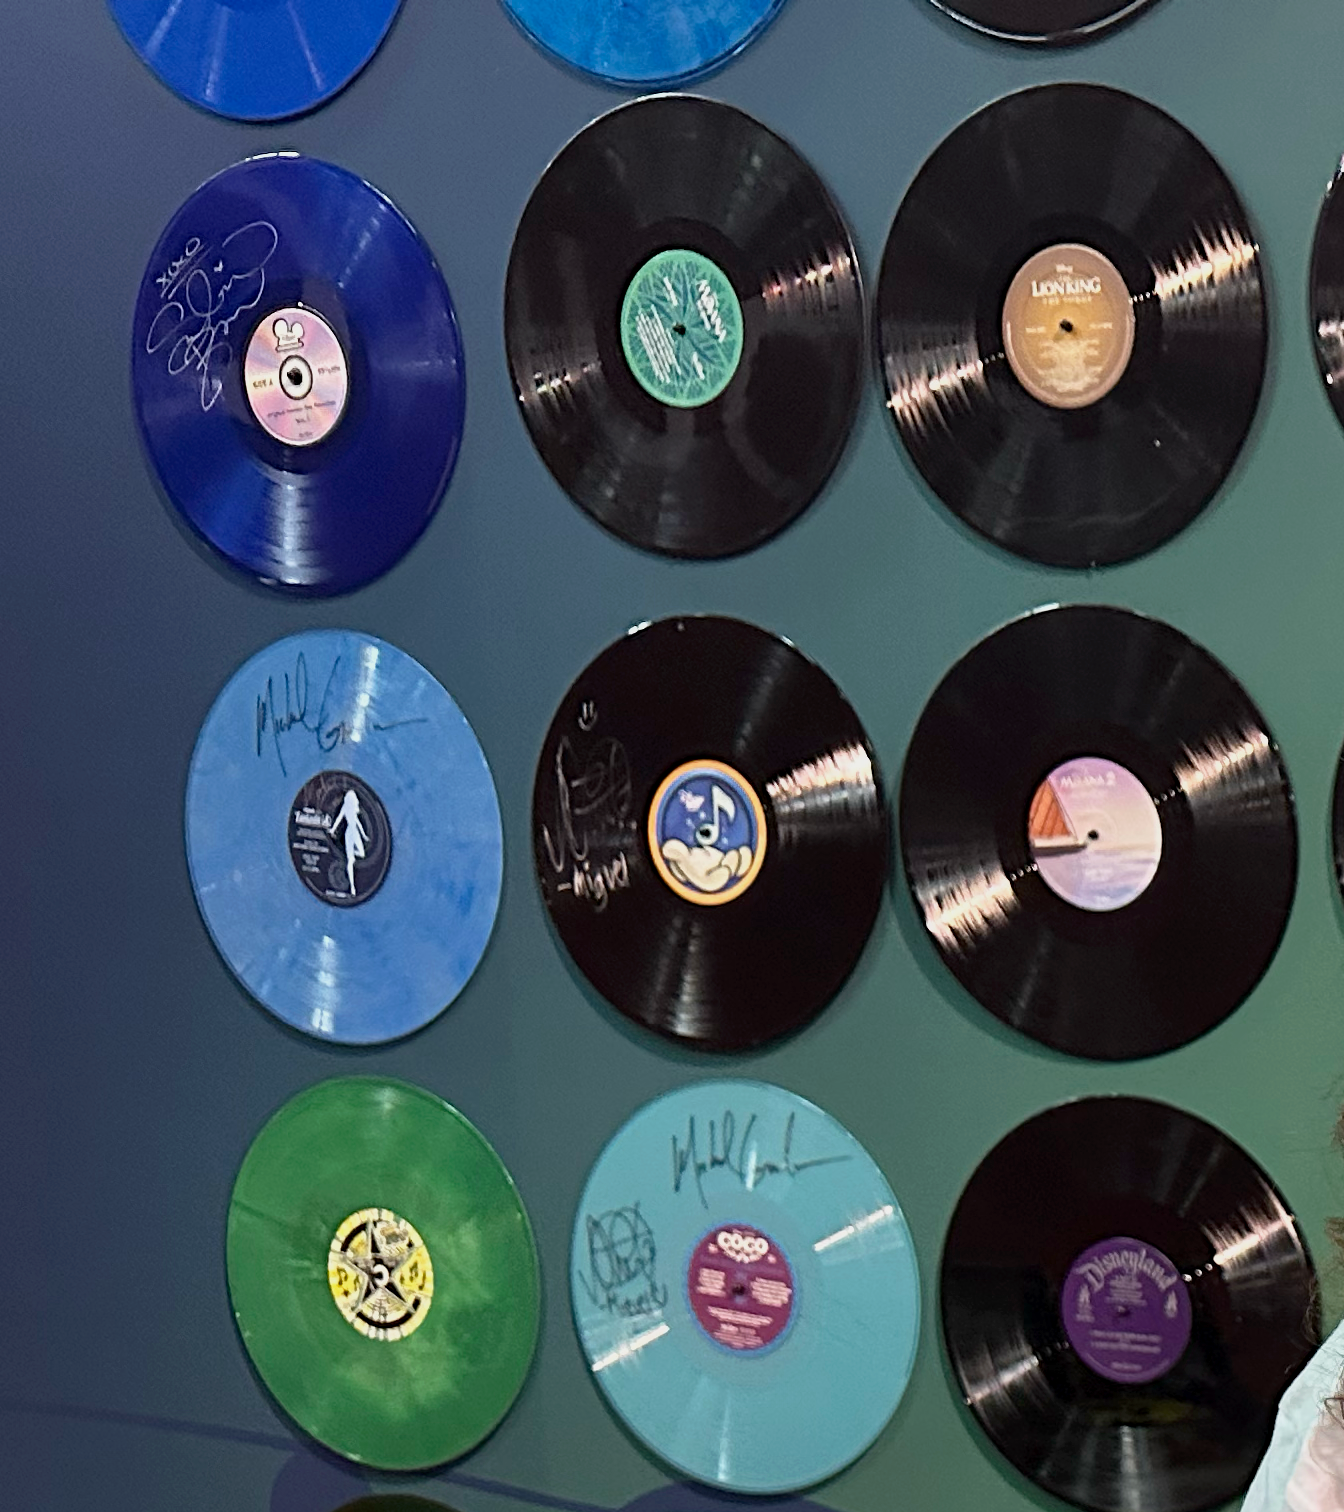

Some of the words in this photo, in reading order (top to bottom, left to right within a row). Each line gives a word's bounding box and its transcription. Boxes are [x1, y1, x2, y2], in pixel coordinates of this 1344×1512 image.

[1031, 280, 1065, 297] LION
[1066, 276, 1101, 295] KING
[717, 1231, 769, 1254] COCO
[1074, 1248, 1178, 1293] Disneyland
